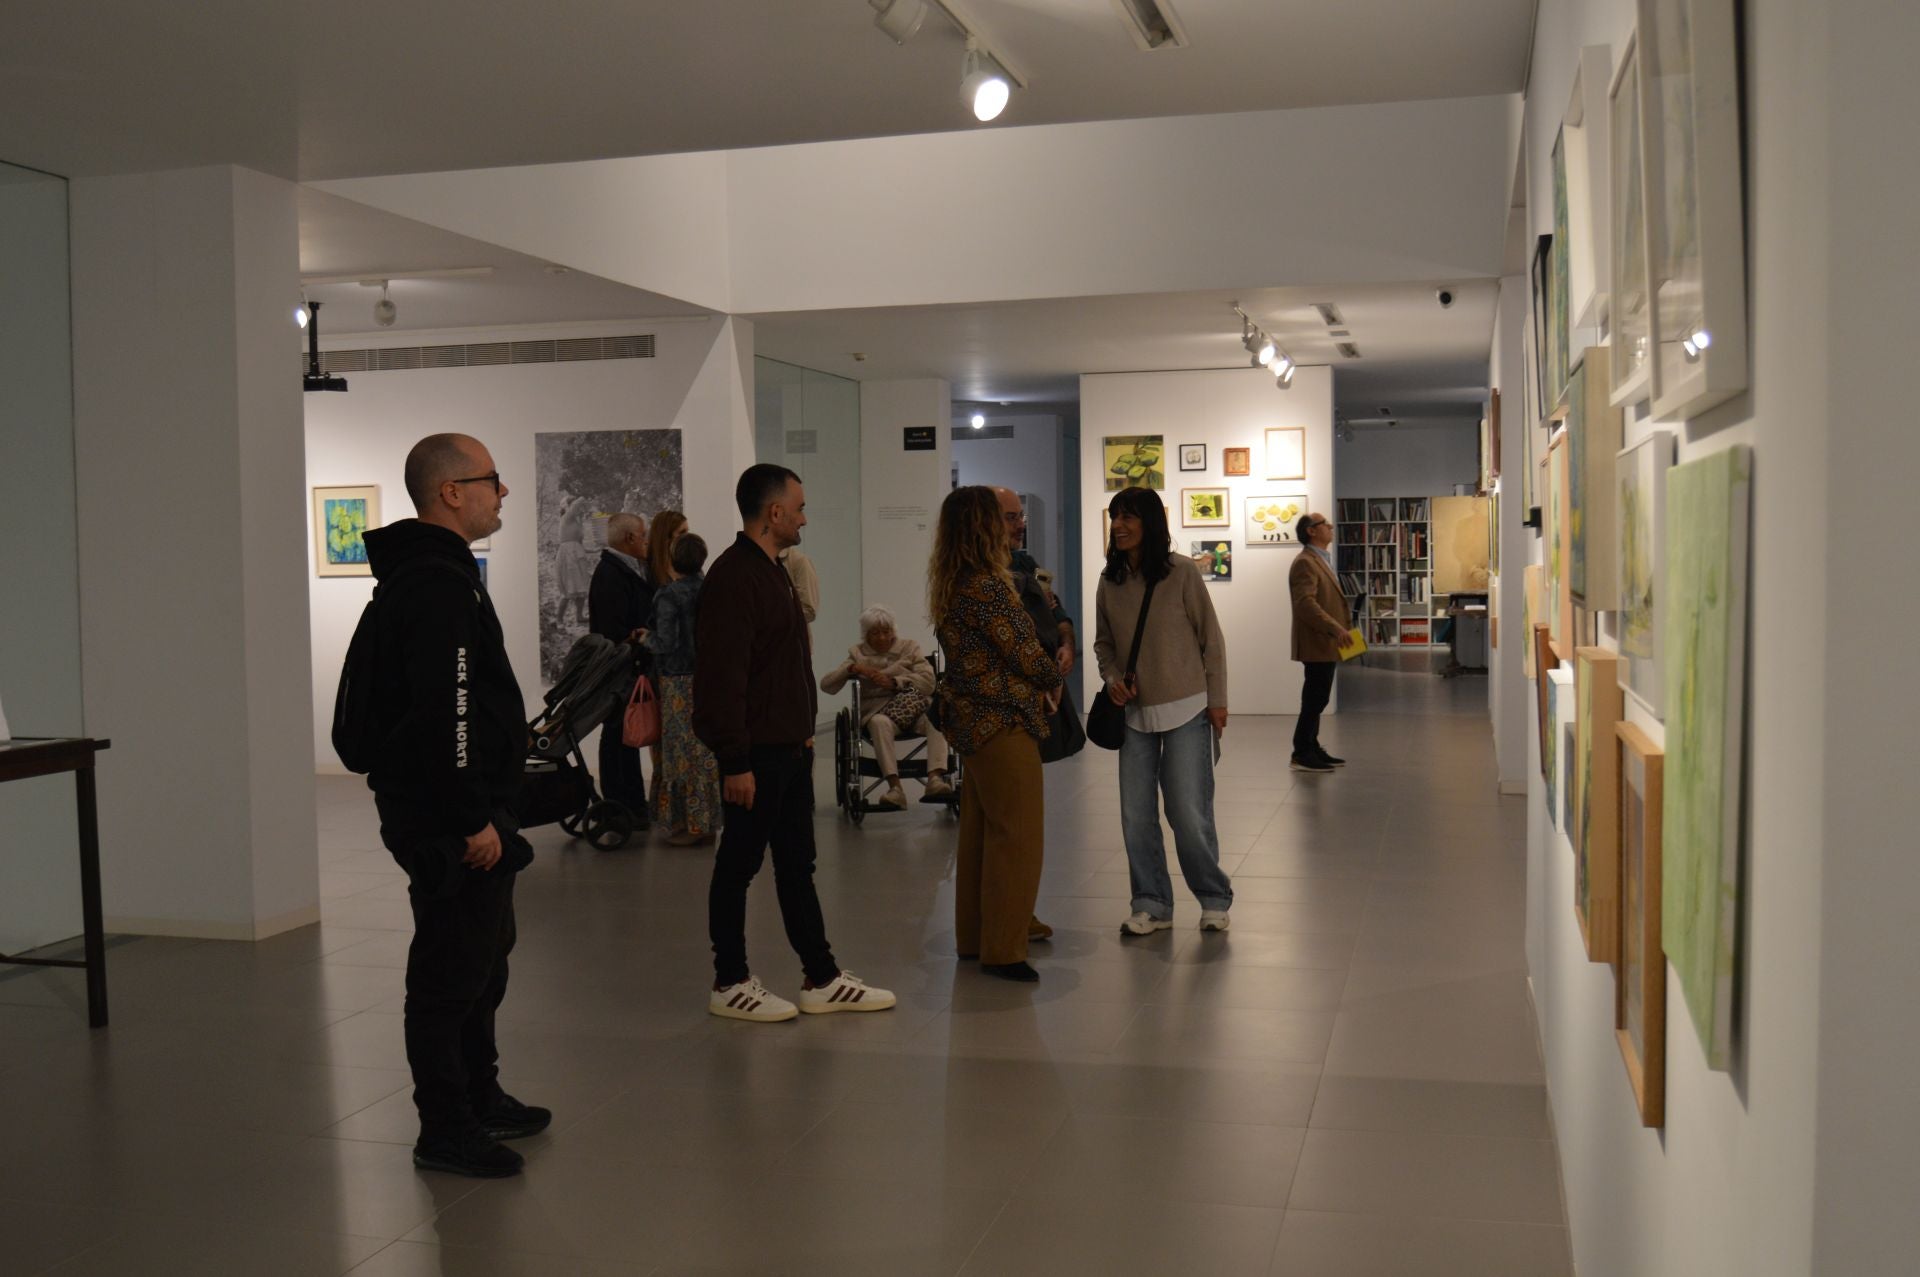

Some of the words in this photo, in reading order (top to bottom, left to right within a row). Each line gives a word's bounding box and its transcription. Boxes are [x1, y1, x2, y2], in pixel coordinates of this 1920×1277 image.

[457, 647, 468, 683] RICK
[456, 687, 468, 716] AND
[456, 721, 468, 768] MORTY
